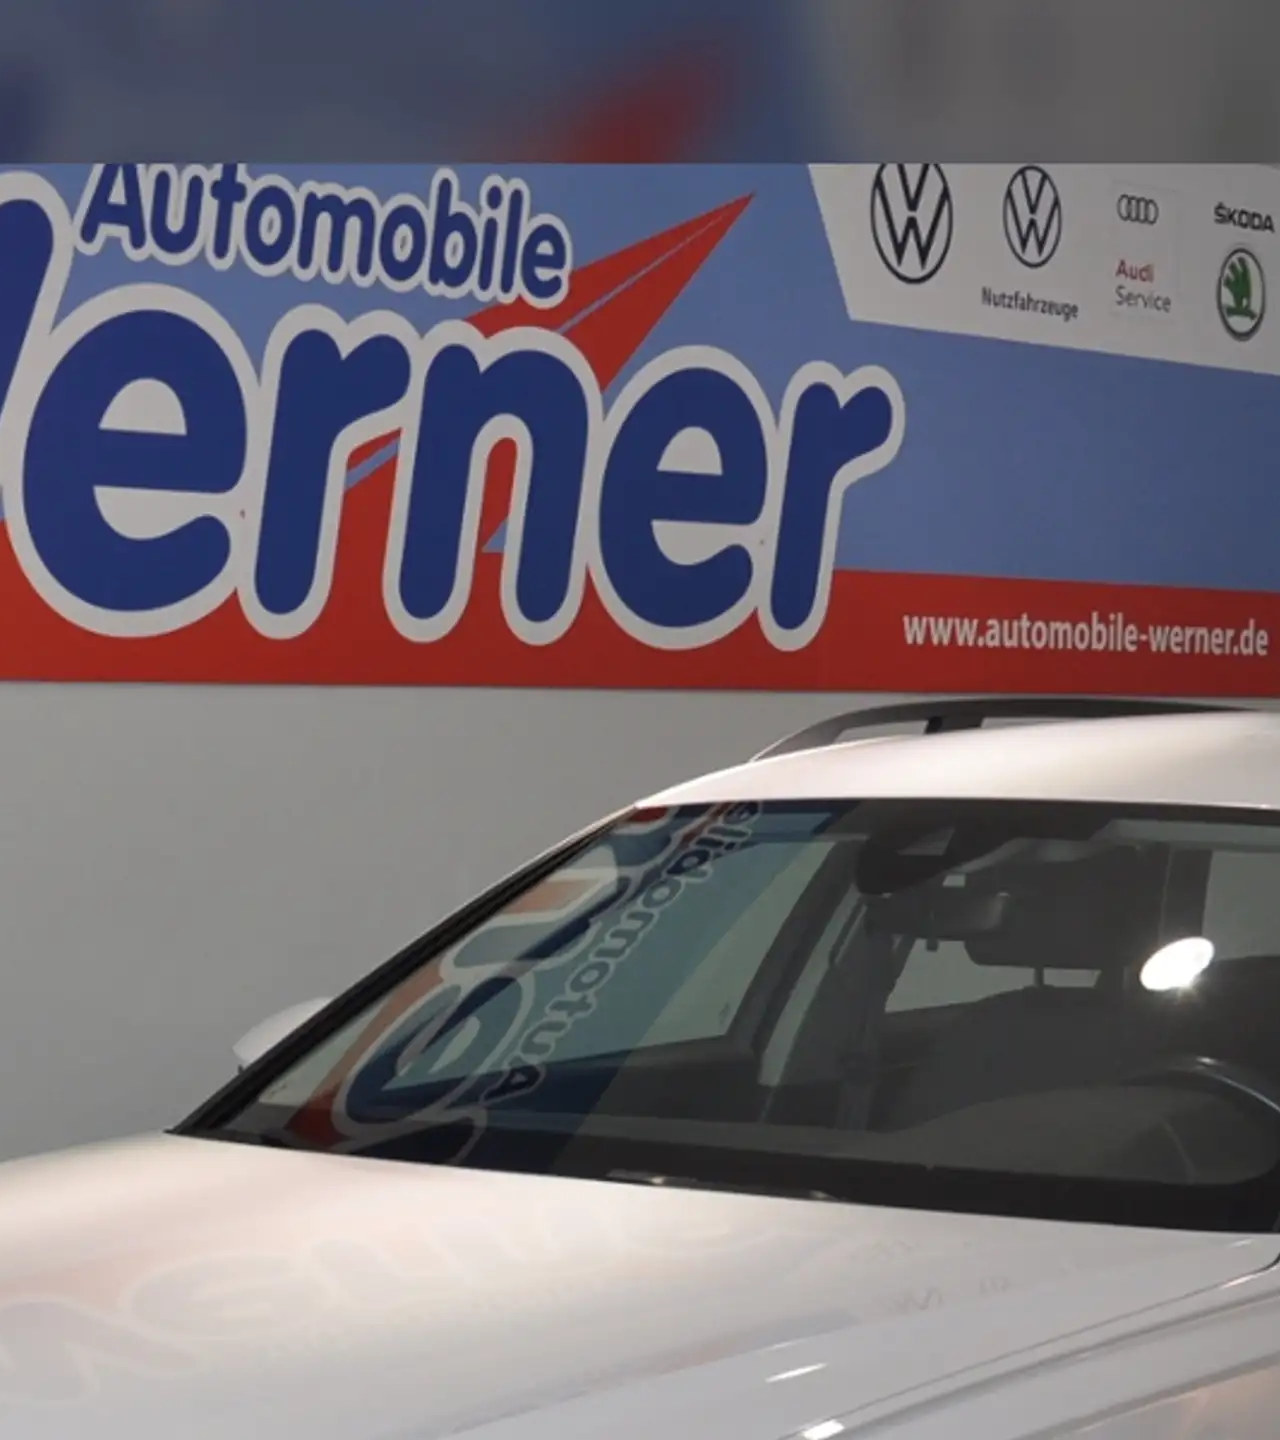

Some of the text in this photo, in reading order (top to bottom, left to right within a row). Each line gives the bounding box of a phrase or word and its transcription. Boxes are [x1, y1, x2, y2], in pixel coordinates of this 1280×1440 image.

[80, 163, 568, 299] Automobile
[1214, 202, 1275, 233] ŠKODA
[1115, 259, 1154, 283] Audi
[981, 286, 1079, 322] Nutzfahrzeuge
[1115, 285, 1172, 313] Service
[902, 611, 1269, 657] www.automobile-werner.de
